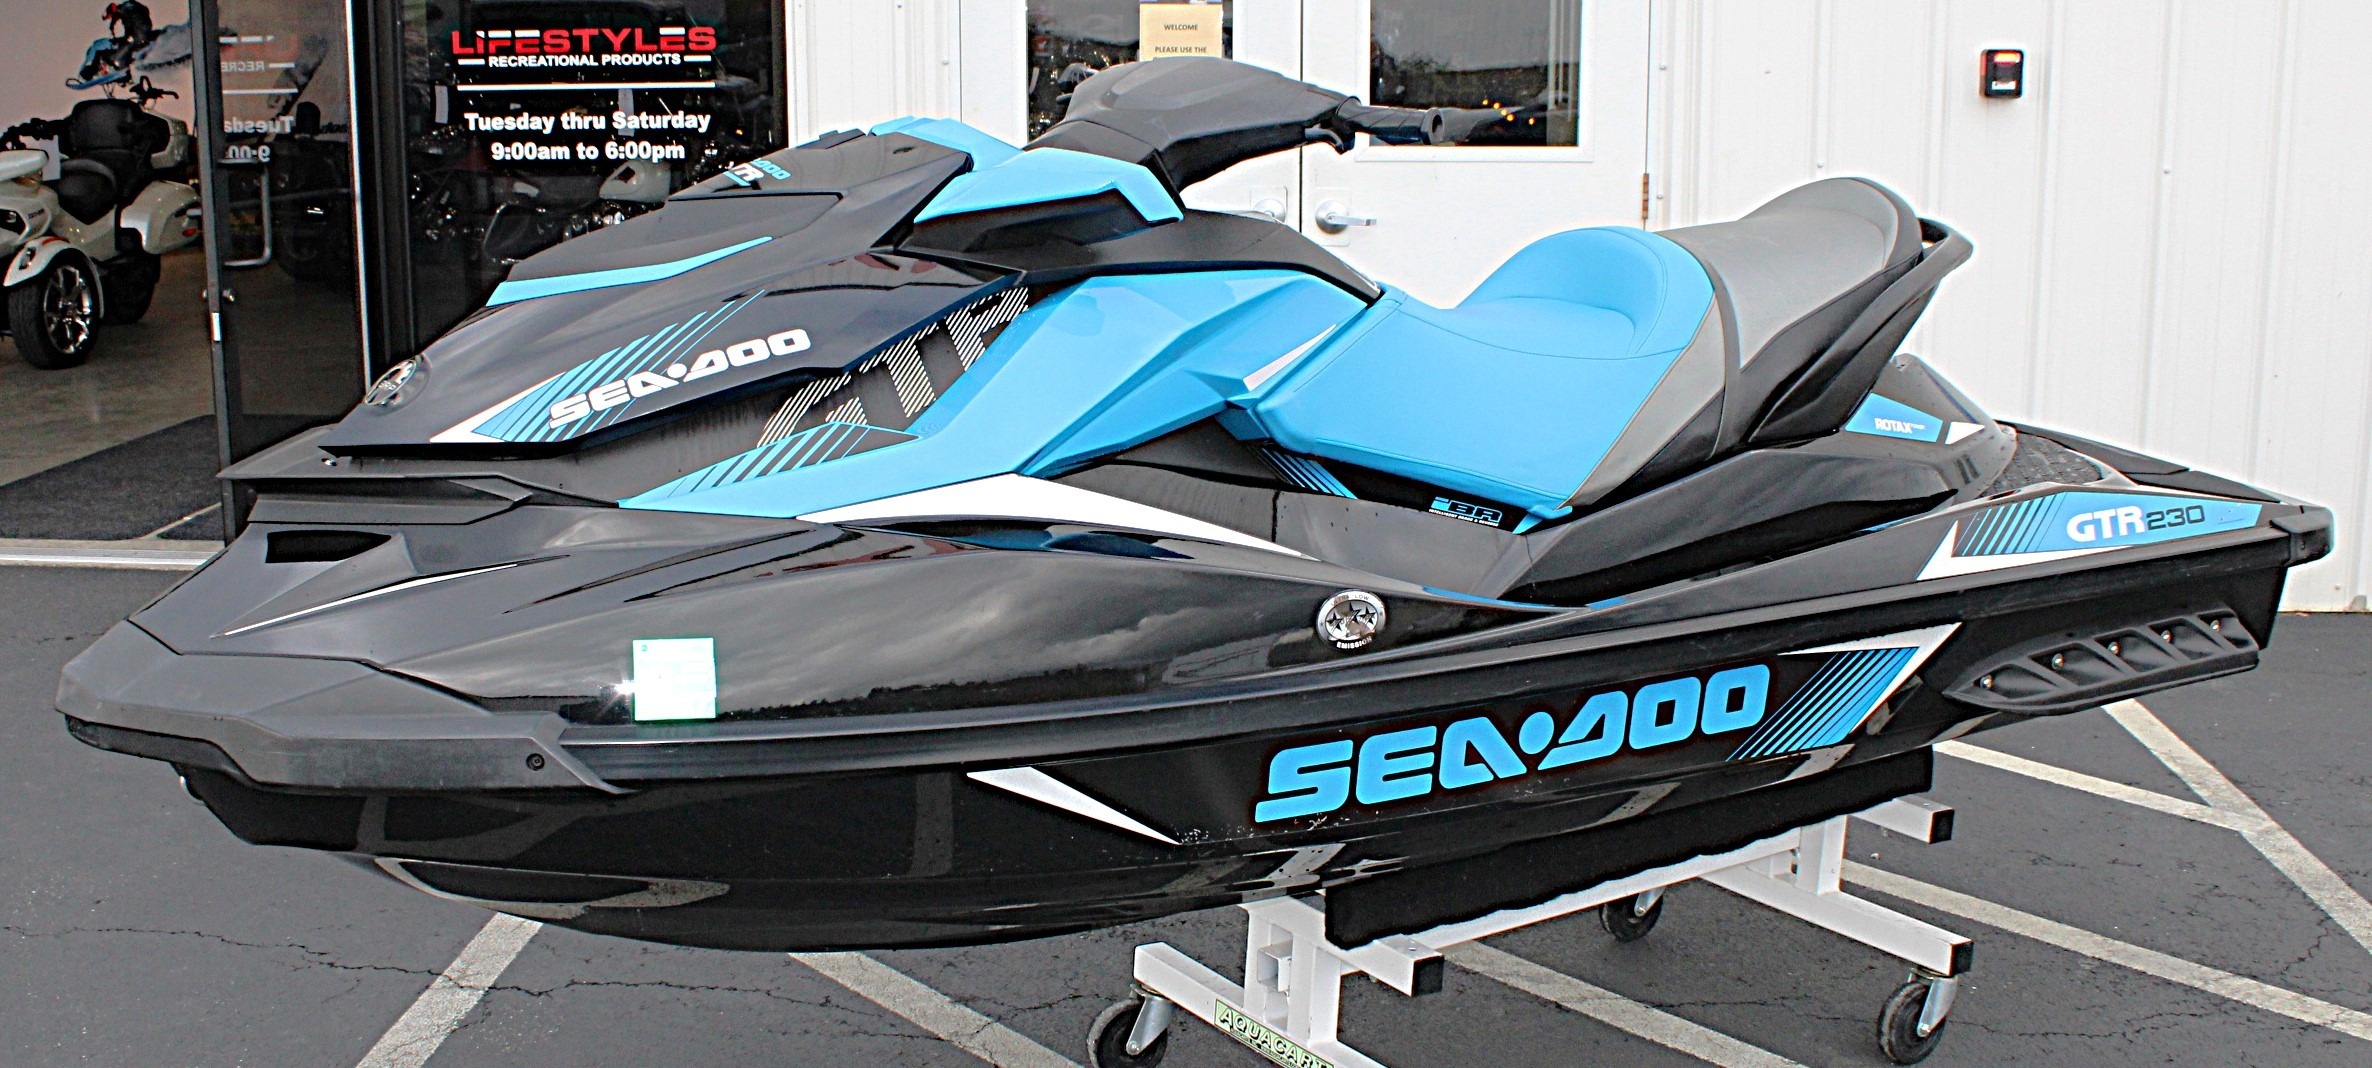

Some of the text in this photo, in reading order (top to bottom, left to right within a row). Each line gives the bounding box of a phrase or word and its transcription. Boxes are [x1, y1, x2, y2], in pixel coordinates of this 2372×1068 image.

[451, 27, 717, 55] LIFESTYLES
[488, 53, 681, 68] RECREATIONAL PRODUCTS
[463, 111, 711, 134] Tuesday thru Saturday
[491, 141, 686, 163] 9:00am to 6:00pm
[1874, 417, 1913, 434] ROTAX
[1336, 636, 1372, 648] EMISSION
